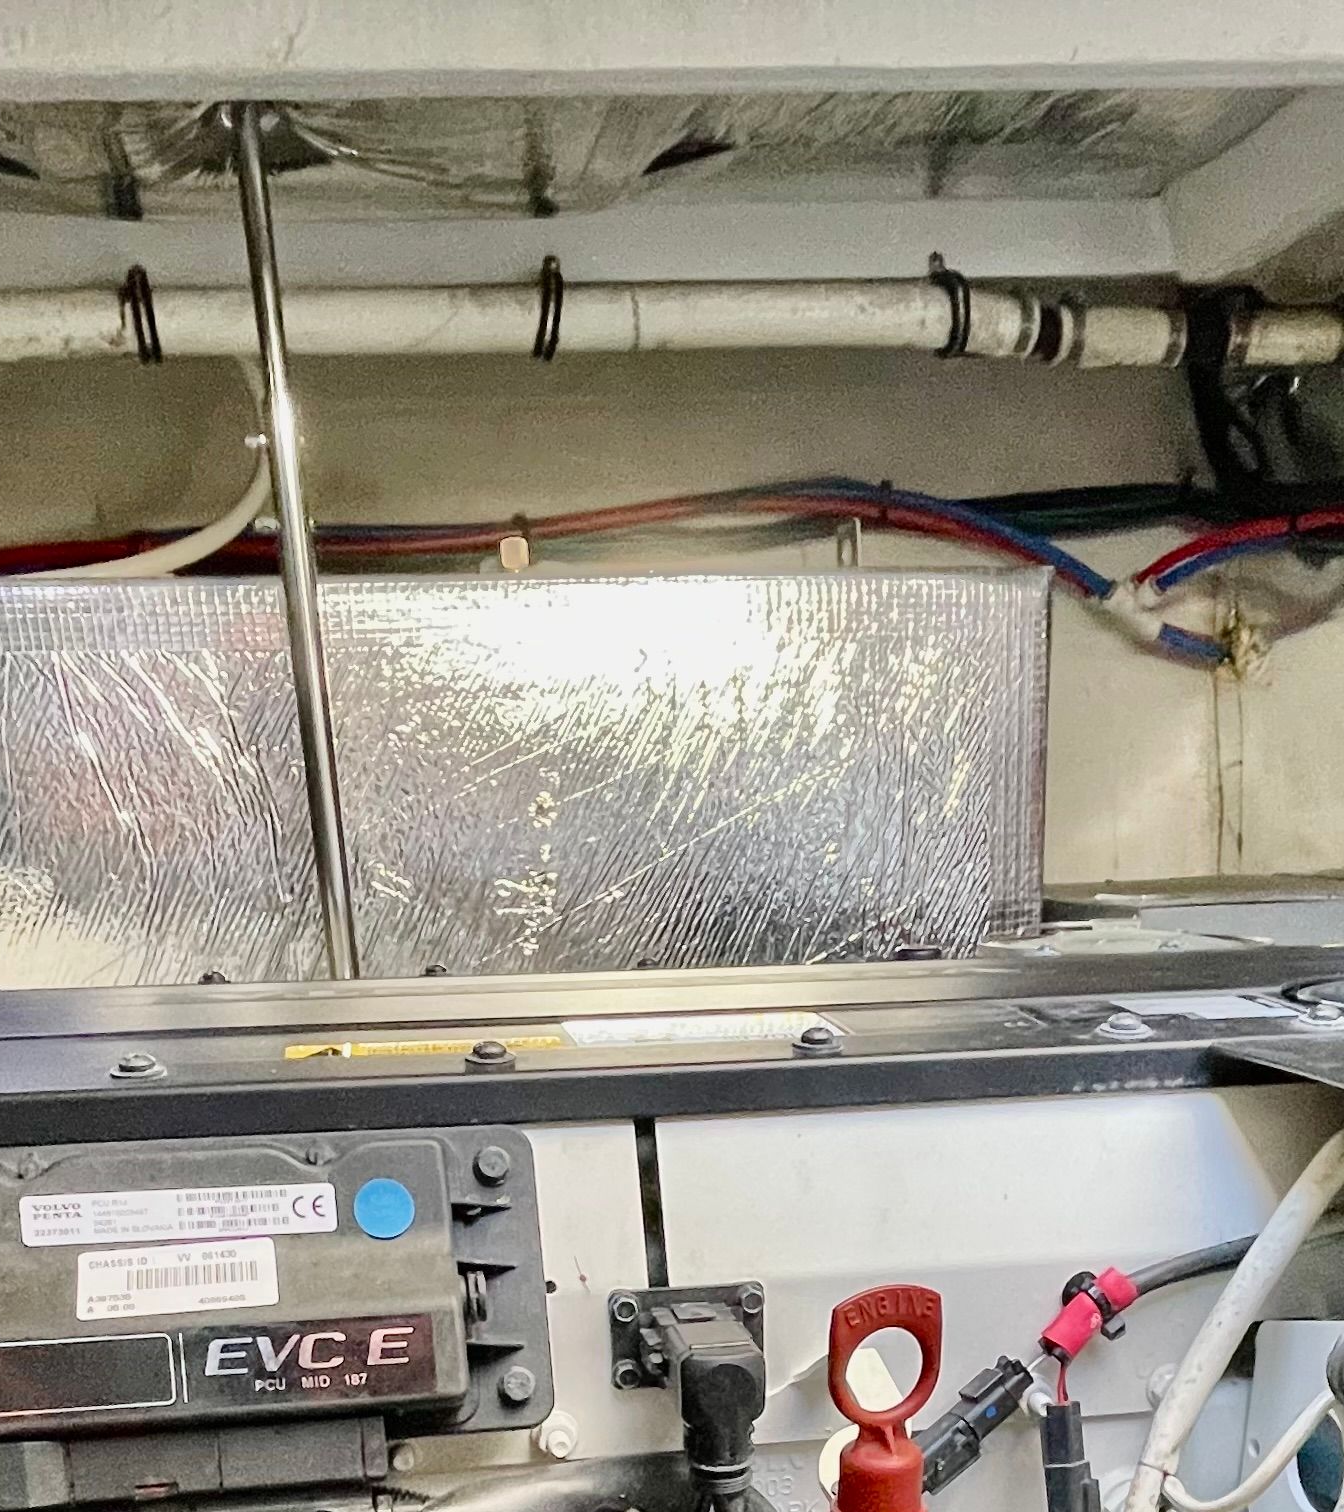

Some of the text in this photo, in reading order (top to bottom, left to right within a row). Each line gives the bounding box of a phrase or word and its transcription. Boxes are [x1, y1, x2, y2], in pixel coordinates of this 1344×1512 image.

[32, 1203, 82, 1212] VOLVO
[33, 1212, 83, 1220] PENTA
[89, 1257, 134, 1270] CHASSIS
[137, 1256, 148, 1266] ID
[843, 1289, 936, 1327] ENGINE
[205, 1327, 414, 1376] EVC E
[254, 1372, 368, 1392] PCU MID 187
